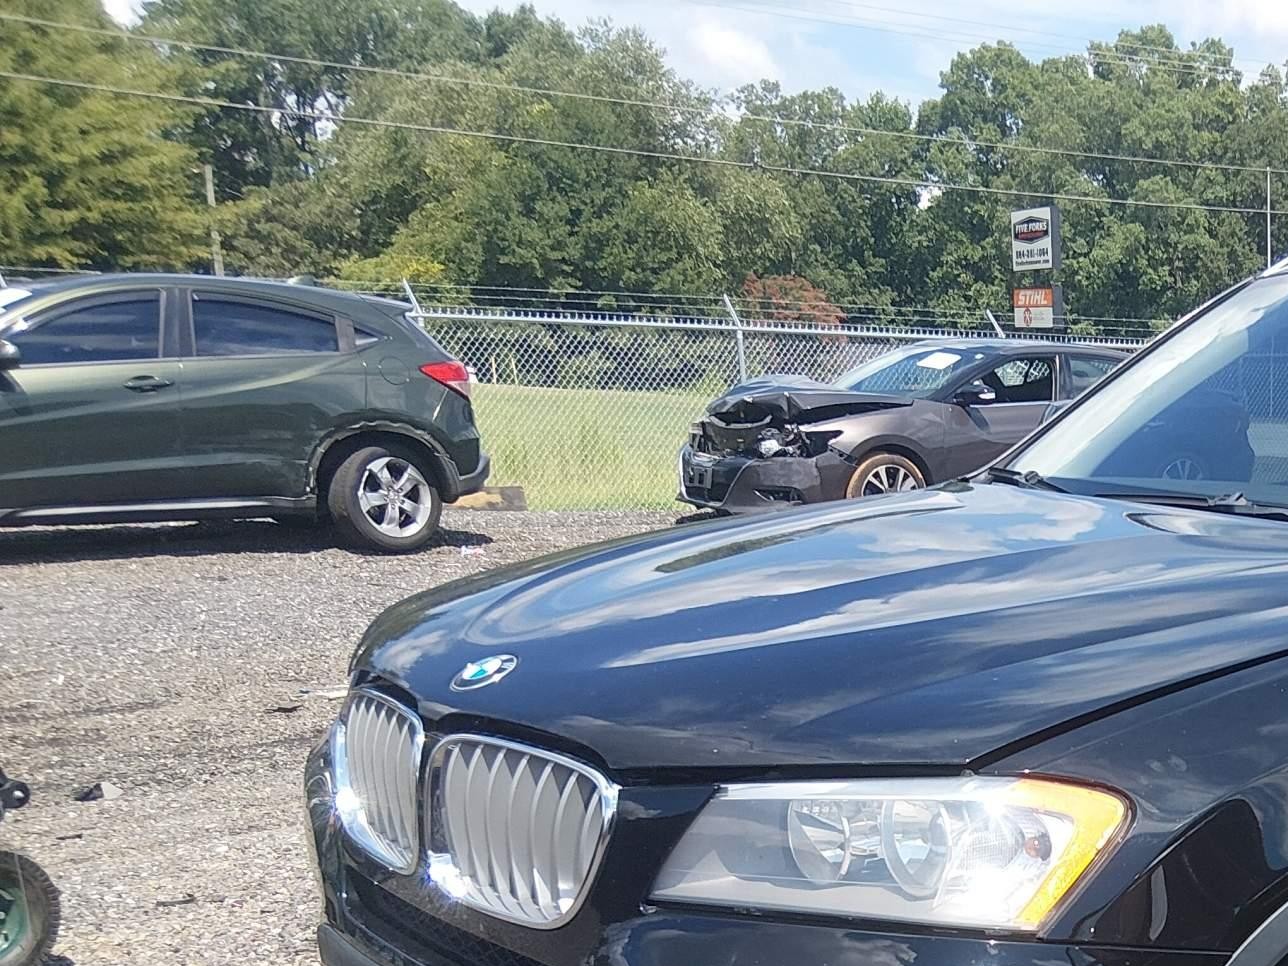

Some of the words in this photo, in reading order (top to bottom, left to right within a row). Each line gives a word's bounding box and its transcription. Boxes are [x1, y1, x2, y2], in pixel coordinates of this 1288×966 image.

[1015, 224, 1028, 234] FIVE
[1029, 222, 1047, 232] FORKS
[1018, 289, 1048, 305] STIHL
